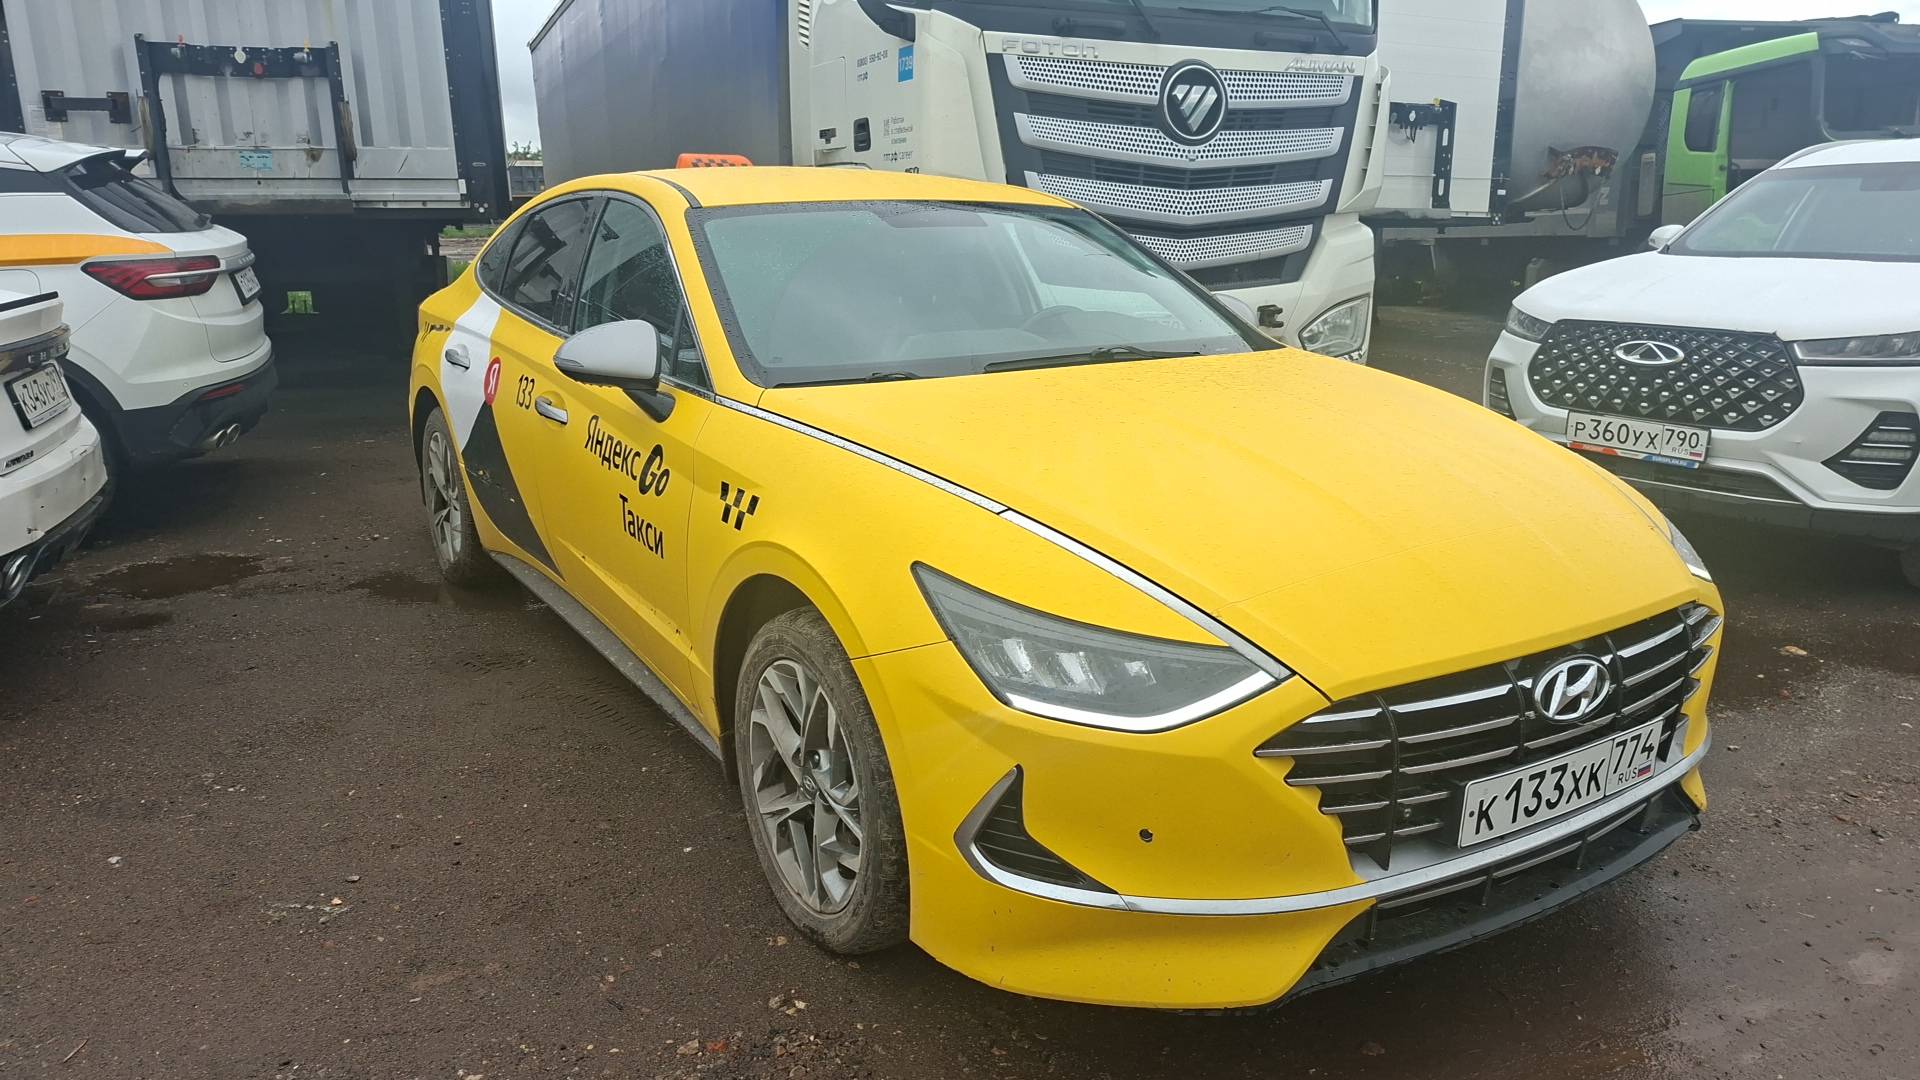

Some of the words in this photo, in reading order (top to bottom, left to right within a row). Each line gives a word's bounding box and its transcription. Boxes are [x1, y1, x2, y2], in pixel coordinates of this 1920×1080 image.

[487, 363, 499, 394] Я
[516, 374, 535, 410] 133
[1574, 419, 1659, 450] Р360УХ
[1665, 428, 1699, 449] 790
[1672, 446, 1689, 456] RUS
[584, 415, 641, 481] Яндекс
[639, 444, 670, 496] Go
[619, 493, 664, 559] Такси
[1474, 758, 1606, 835] К133ХК
[1613, 729, 1655, 774] 774
[1617, 767, 1638, 785] RUS
